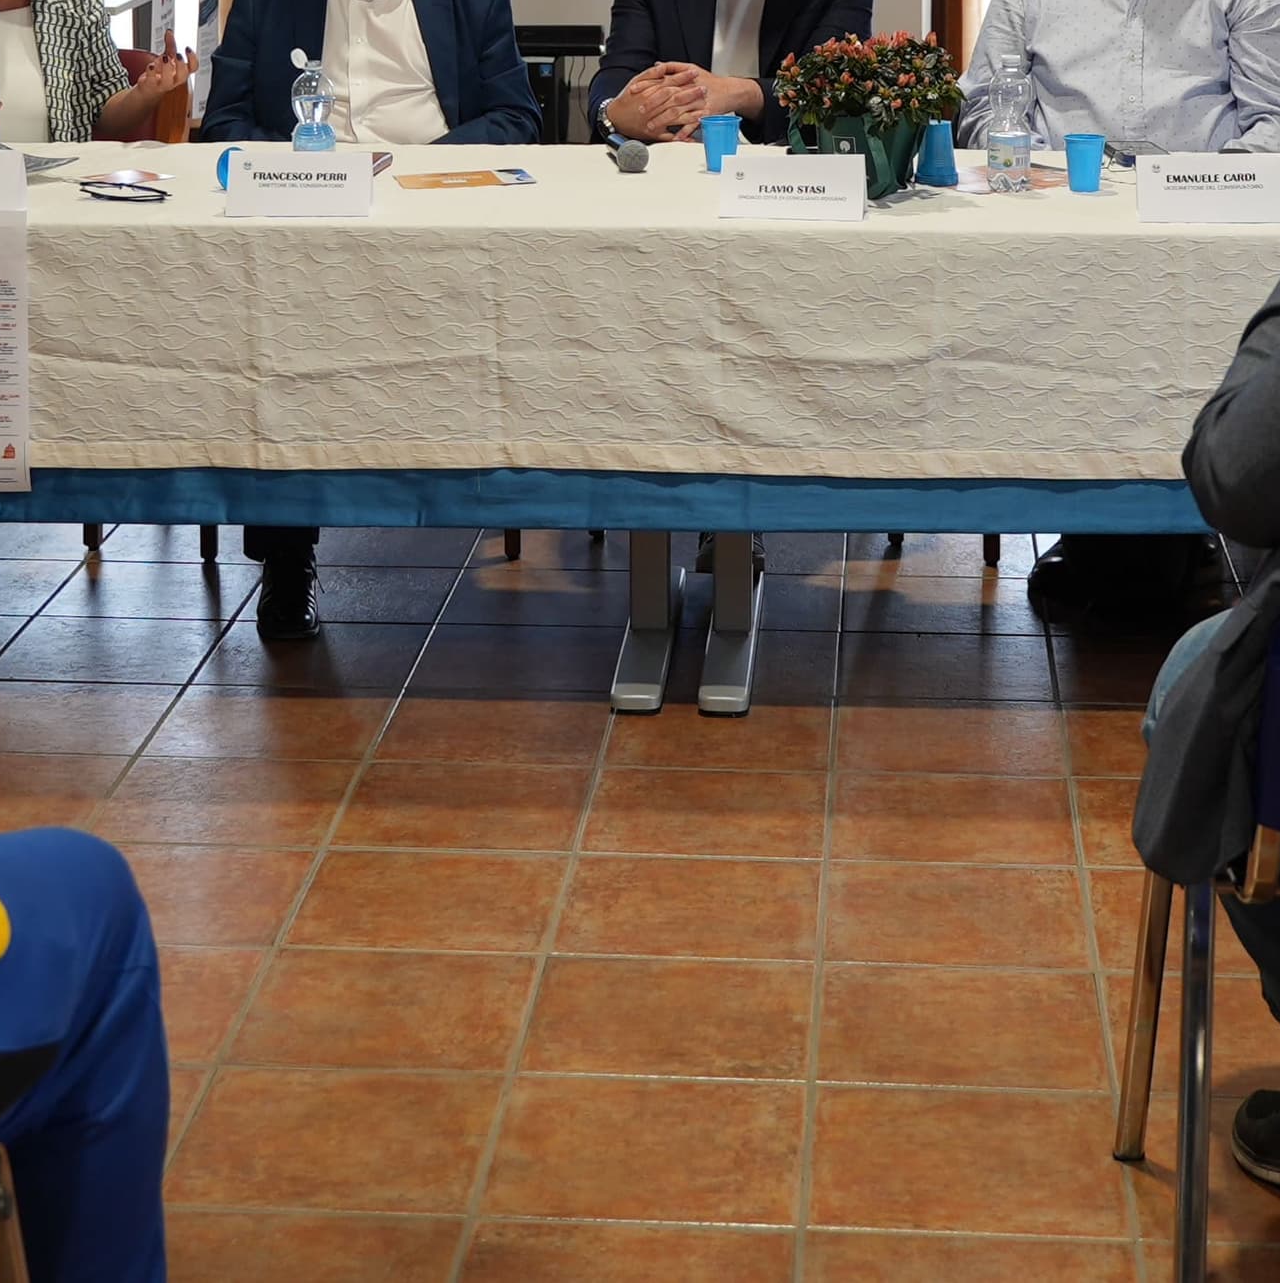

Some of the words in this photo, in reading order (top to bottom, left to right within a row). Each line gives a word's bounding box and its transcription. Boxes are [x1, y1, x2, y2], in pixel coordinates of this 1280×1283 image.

[253, 171, 313, 181] FRANCESCO
[316, 172, 347, 181] PERRI
[1166, 173, 1221, 183] EMANUELE
[1223, 172, 1256, 182] CARDI
[758, 184, 794, 194] FLAVIO
[796, 185, 826, 194] STASI
